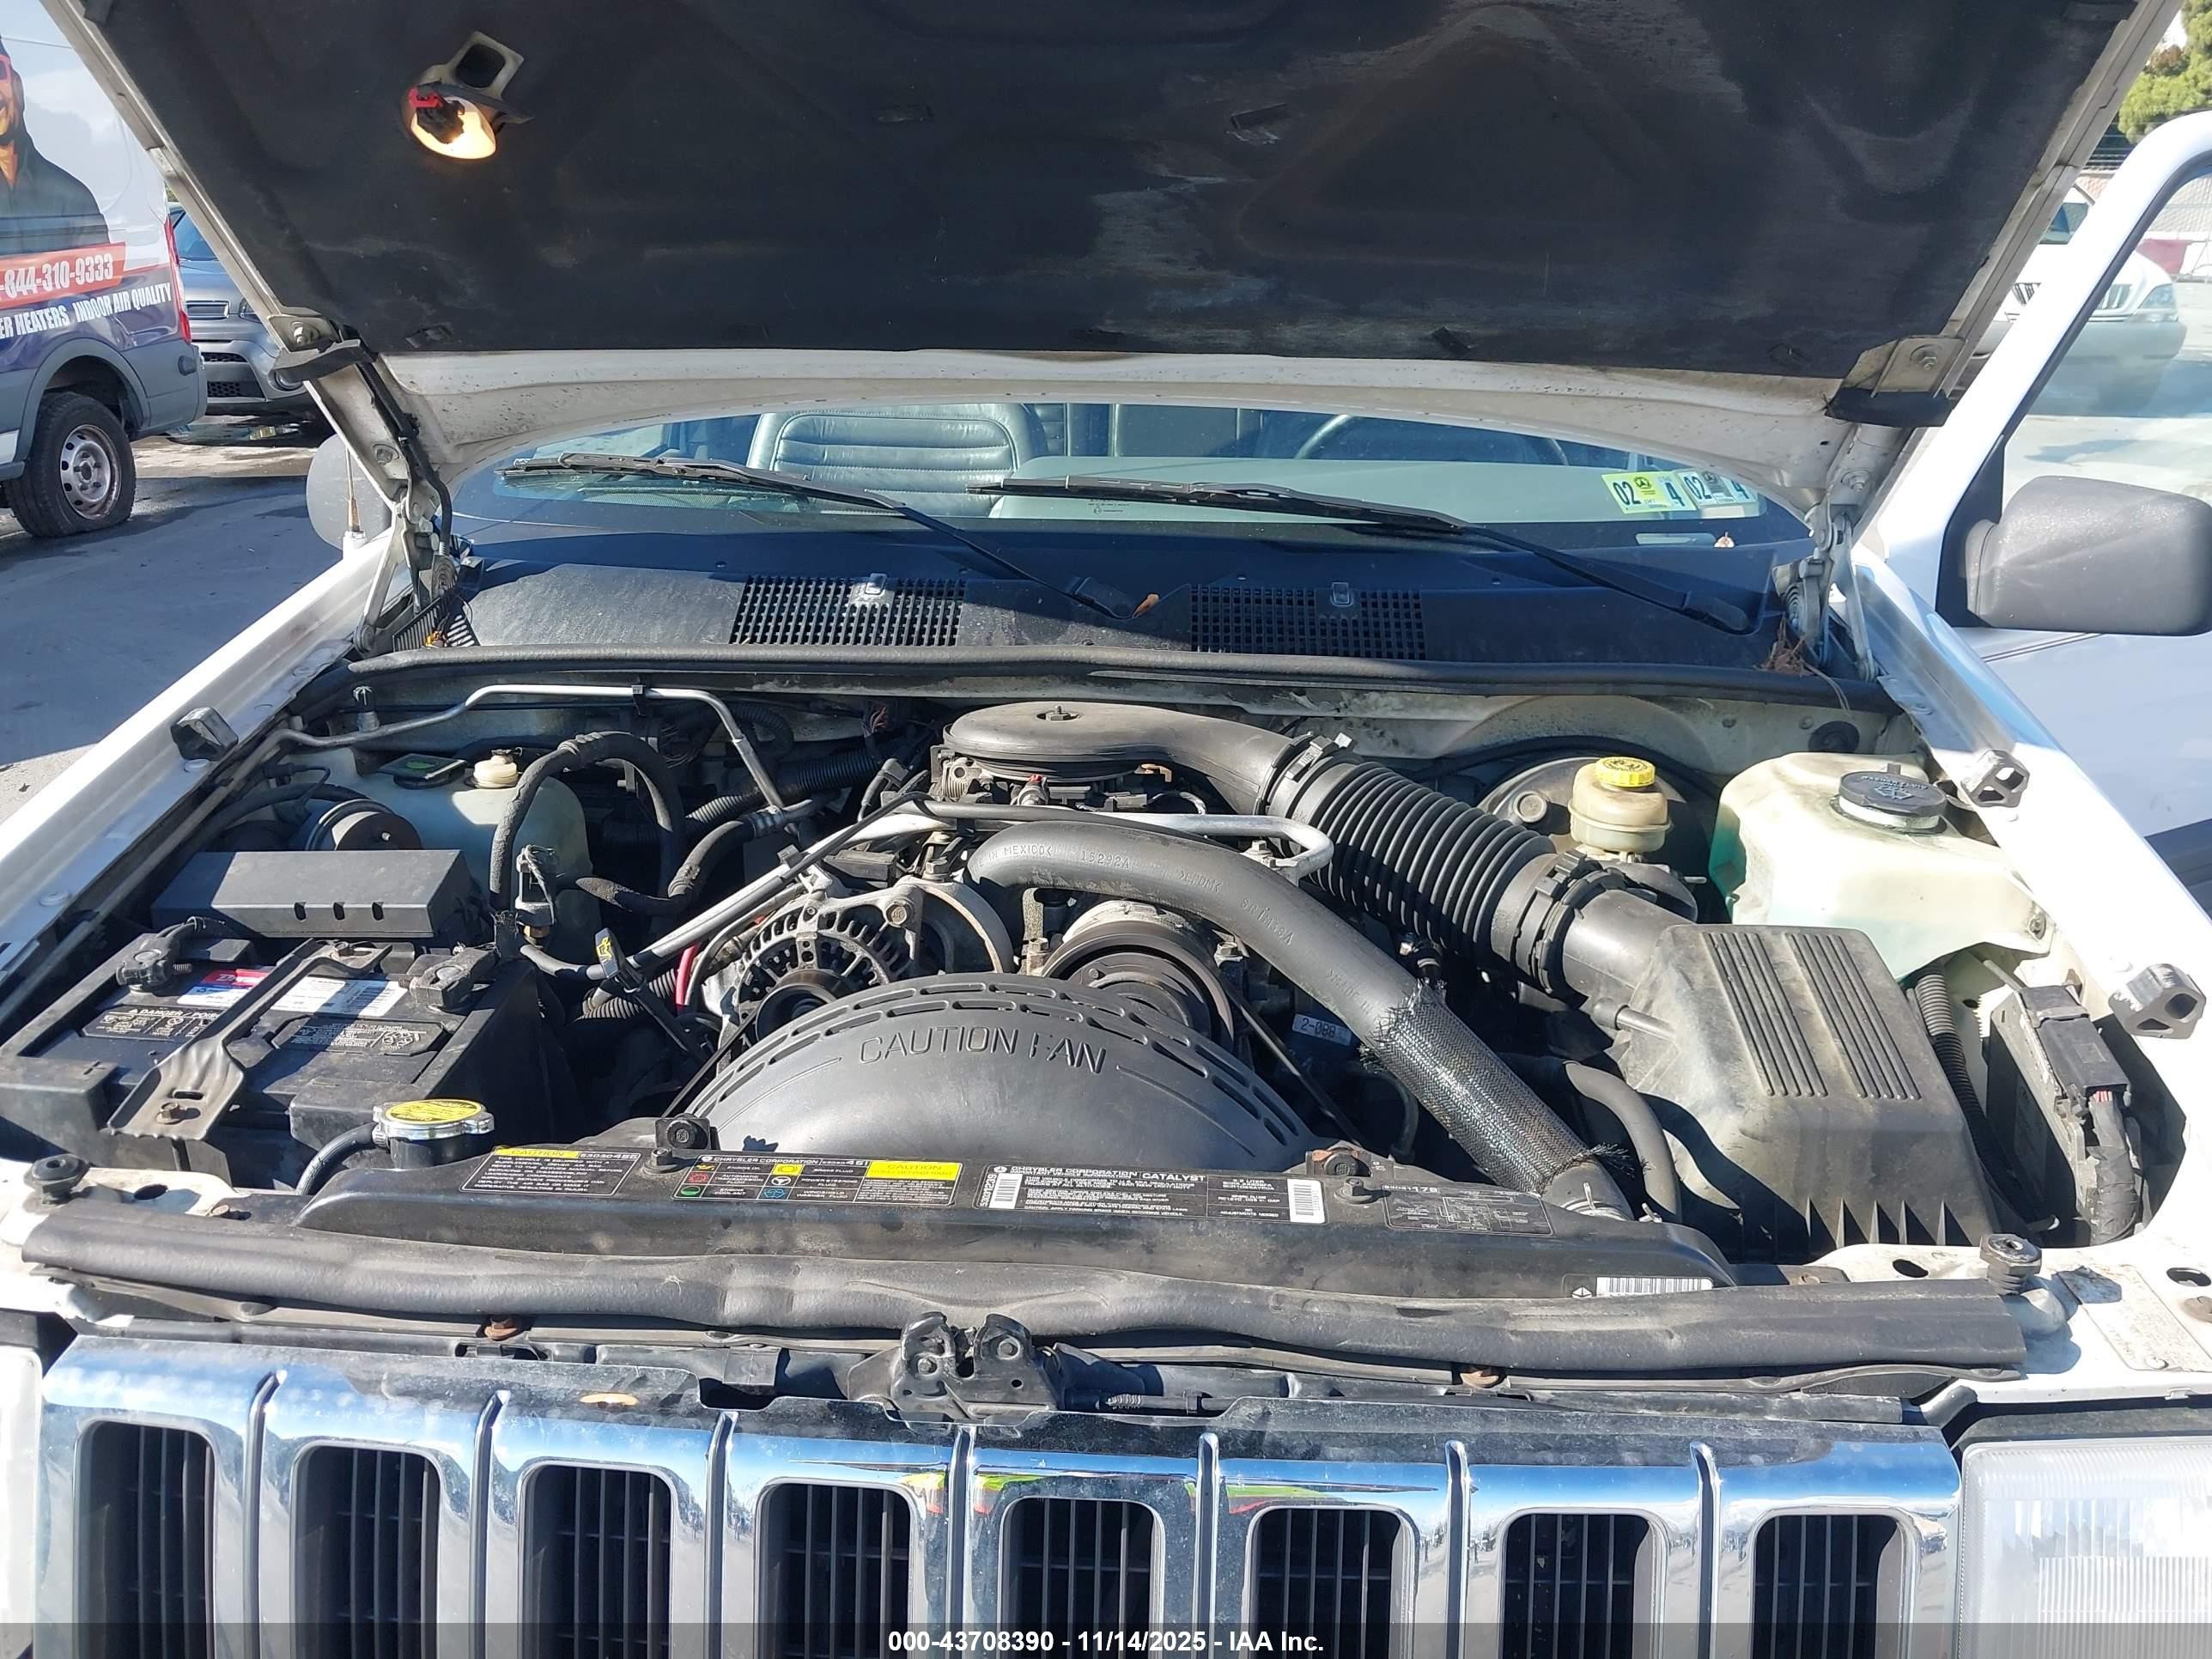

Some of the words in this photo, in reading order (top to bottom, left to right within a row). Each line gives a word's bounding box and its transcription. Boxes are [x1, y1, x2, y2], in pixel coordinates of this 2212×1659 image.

[0, 252, 113, 299] -844-310-9333
[14, 305, 70, 335] HEATERS
[72, 295, 112, 323] INDOOR
[112, 290, 131, 313] AIR
[131, 282, 172, 311] QUALITY
[1612, 481, 1641, 505] 02
[1664, 482, 1686, 507] 4
[1684, 475, 1712, 500] 02
[860, 1026, 1018, 1064] CAUTION
[1029, 1032, 1106, 1074] FAN
[1065, 1168, 1138, 1176] CORPORATION
[1142, 1173, 1206, 1182] CATALYST
